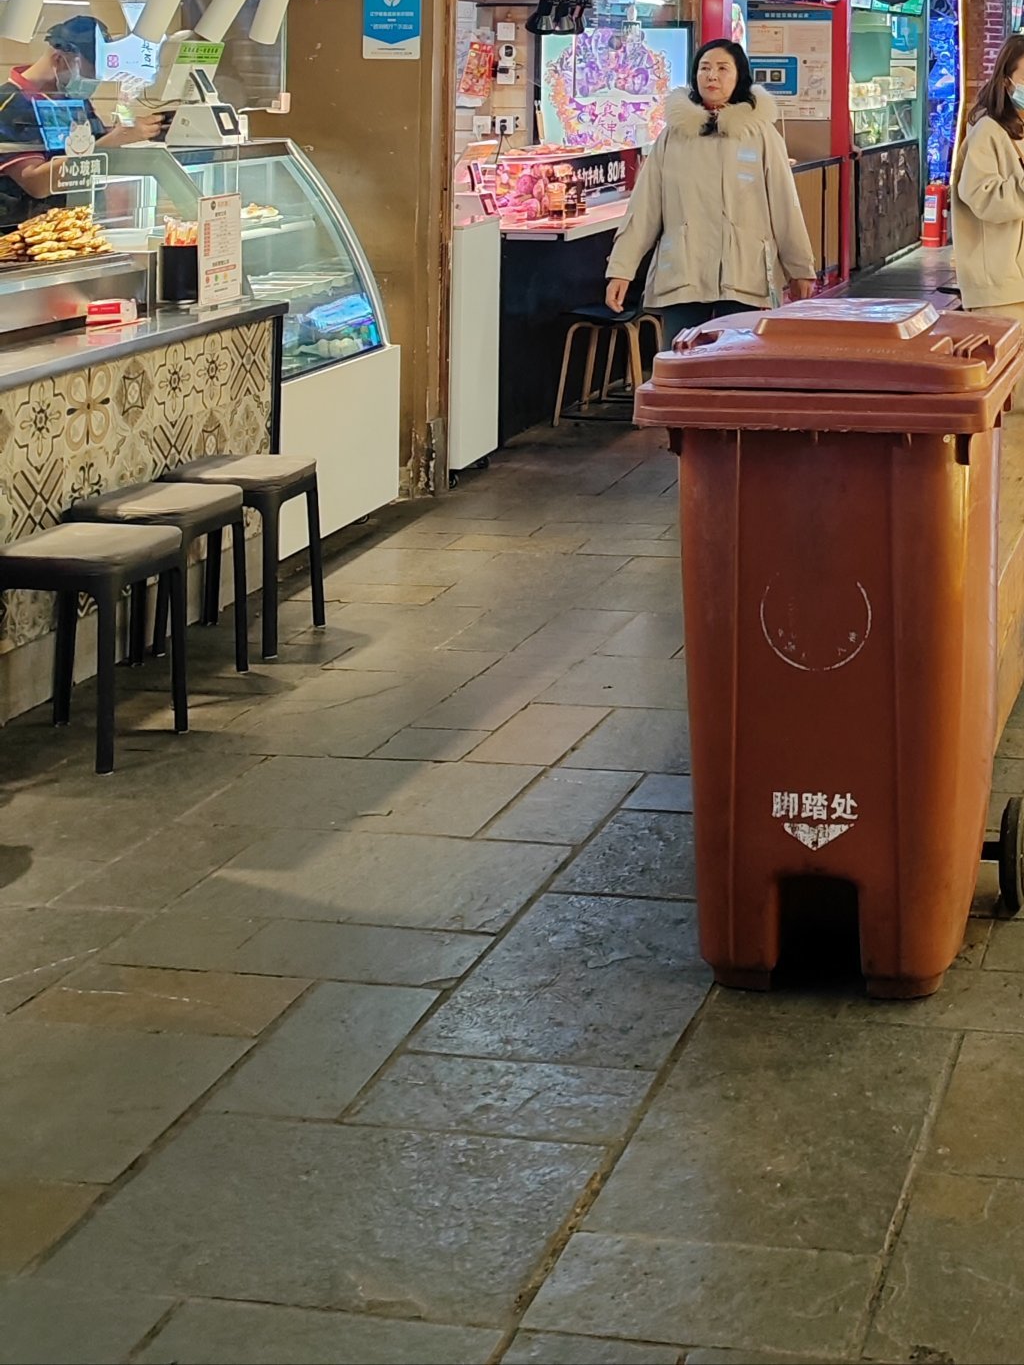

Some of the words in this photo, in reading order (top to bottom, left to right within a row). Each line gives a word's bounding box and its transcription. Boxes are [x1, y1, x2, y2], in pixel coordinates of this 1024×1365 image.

[58, 159, 101, 177] 小心玻璃
[772, 792, 858, 819] 脚踏处
